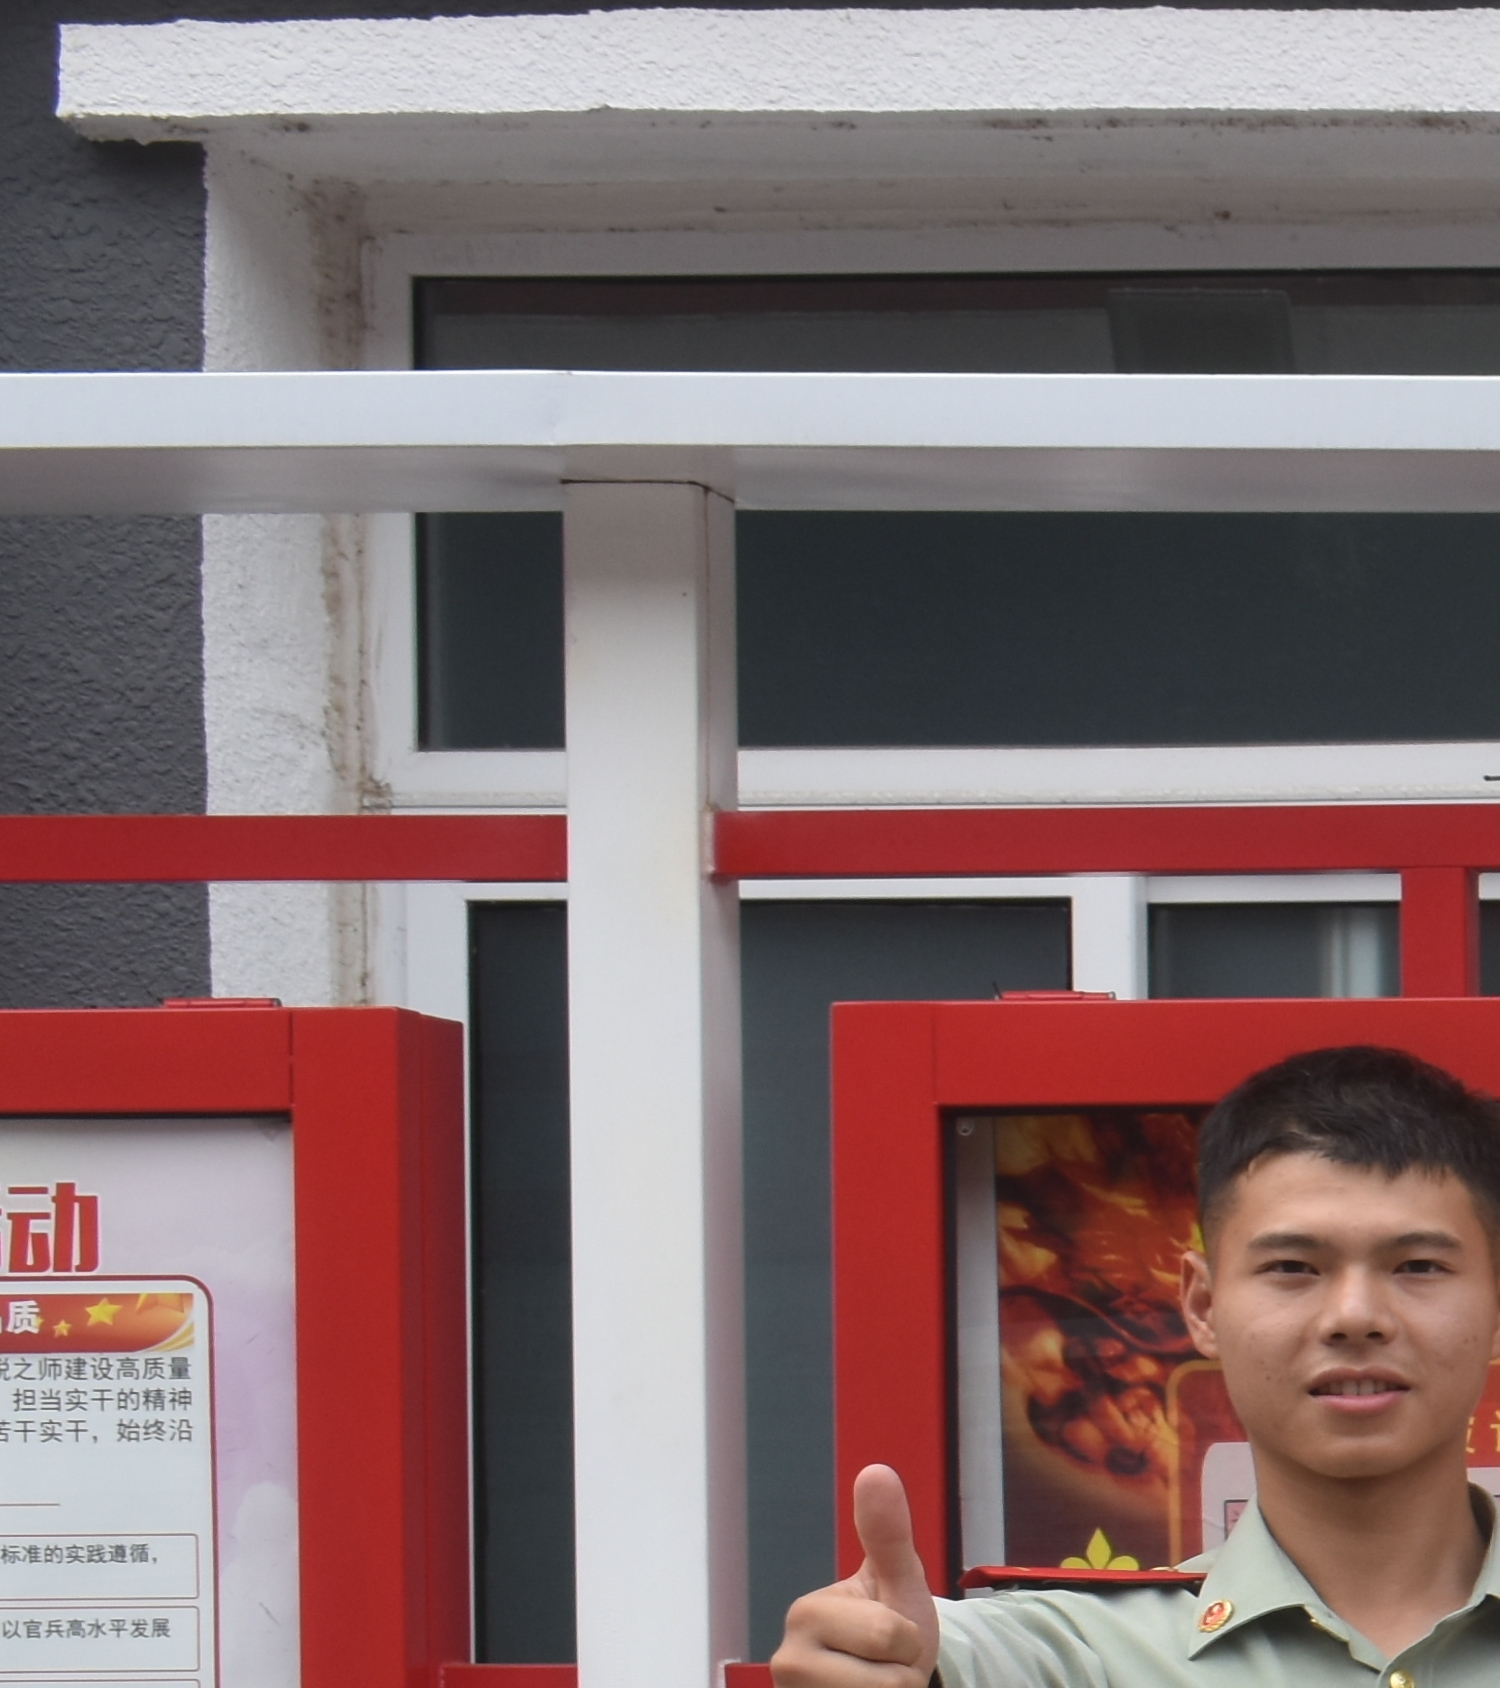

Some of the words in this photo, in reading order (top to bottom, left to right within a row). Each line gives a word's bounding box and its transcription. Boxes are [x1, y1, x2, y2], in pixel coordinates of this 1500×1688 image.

[6, 1181, 99, 1274] 动
[0, 1299, 41, 1335] 质
[13, 1387, 193, 1413] 担当实干的精神
[2, 1618, 171, 1639] 以官兵高水平发展
